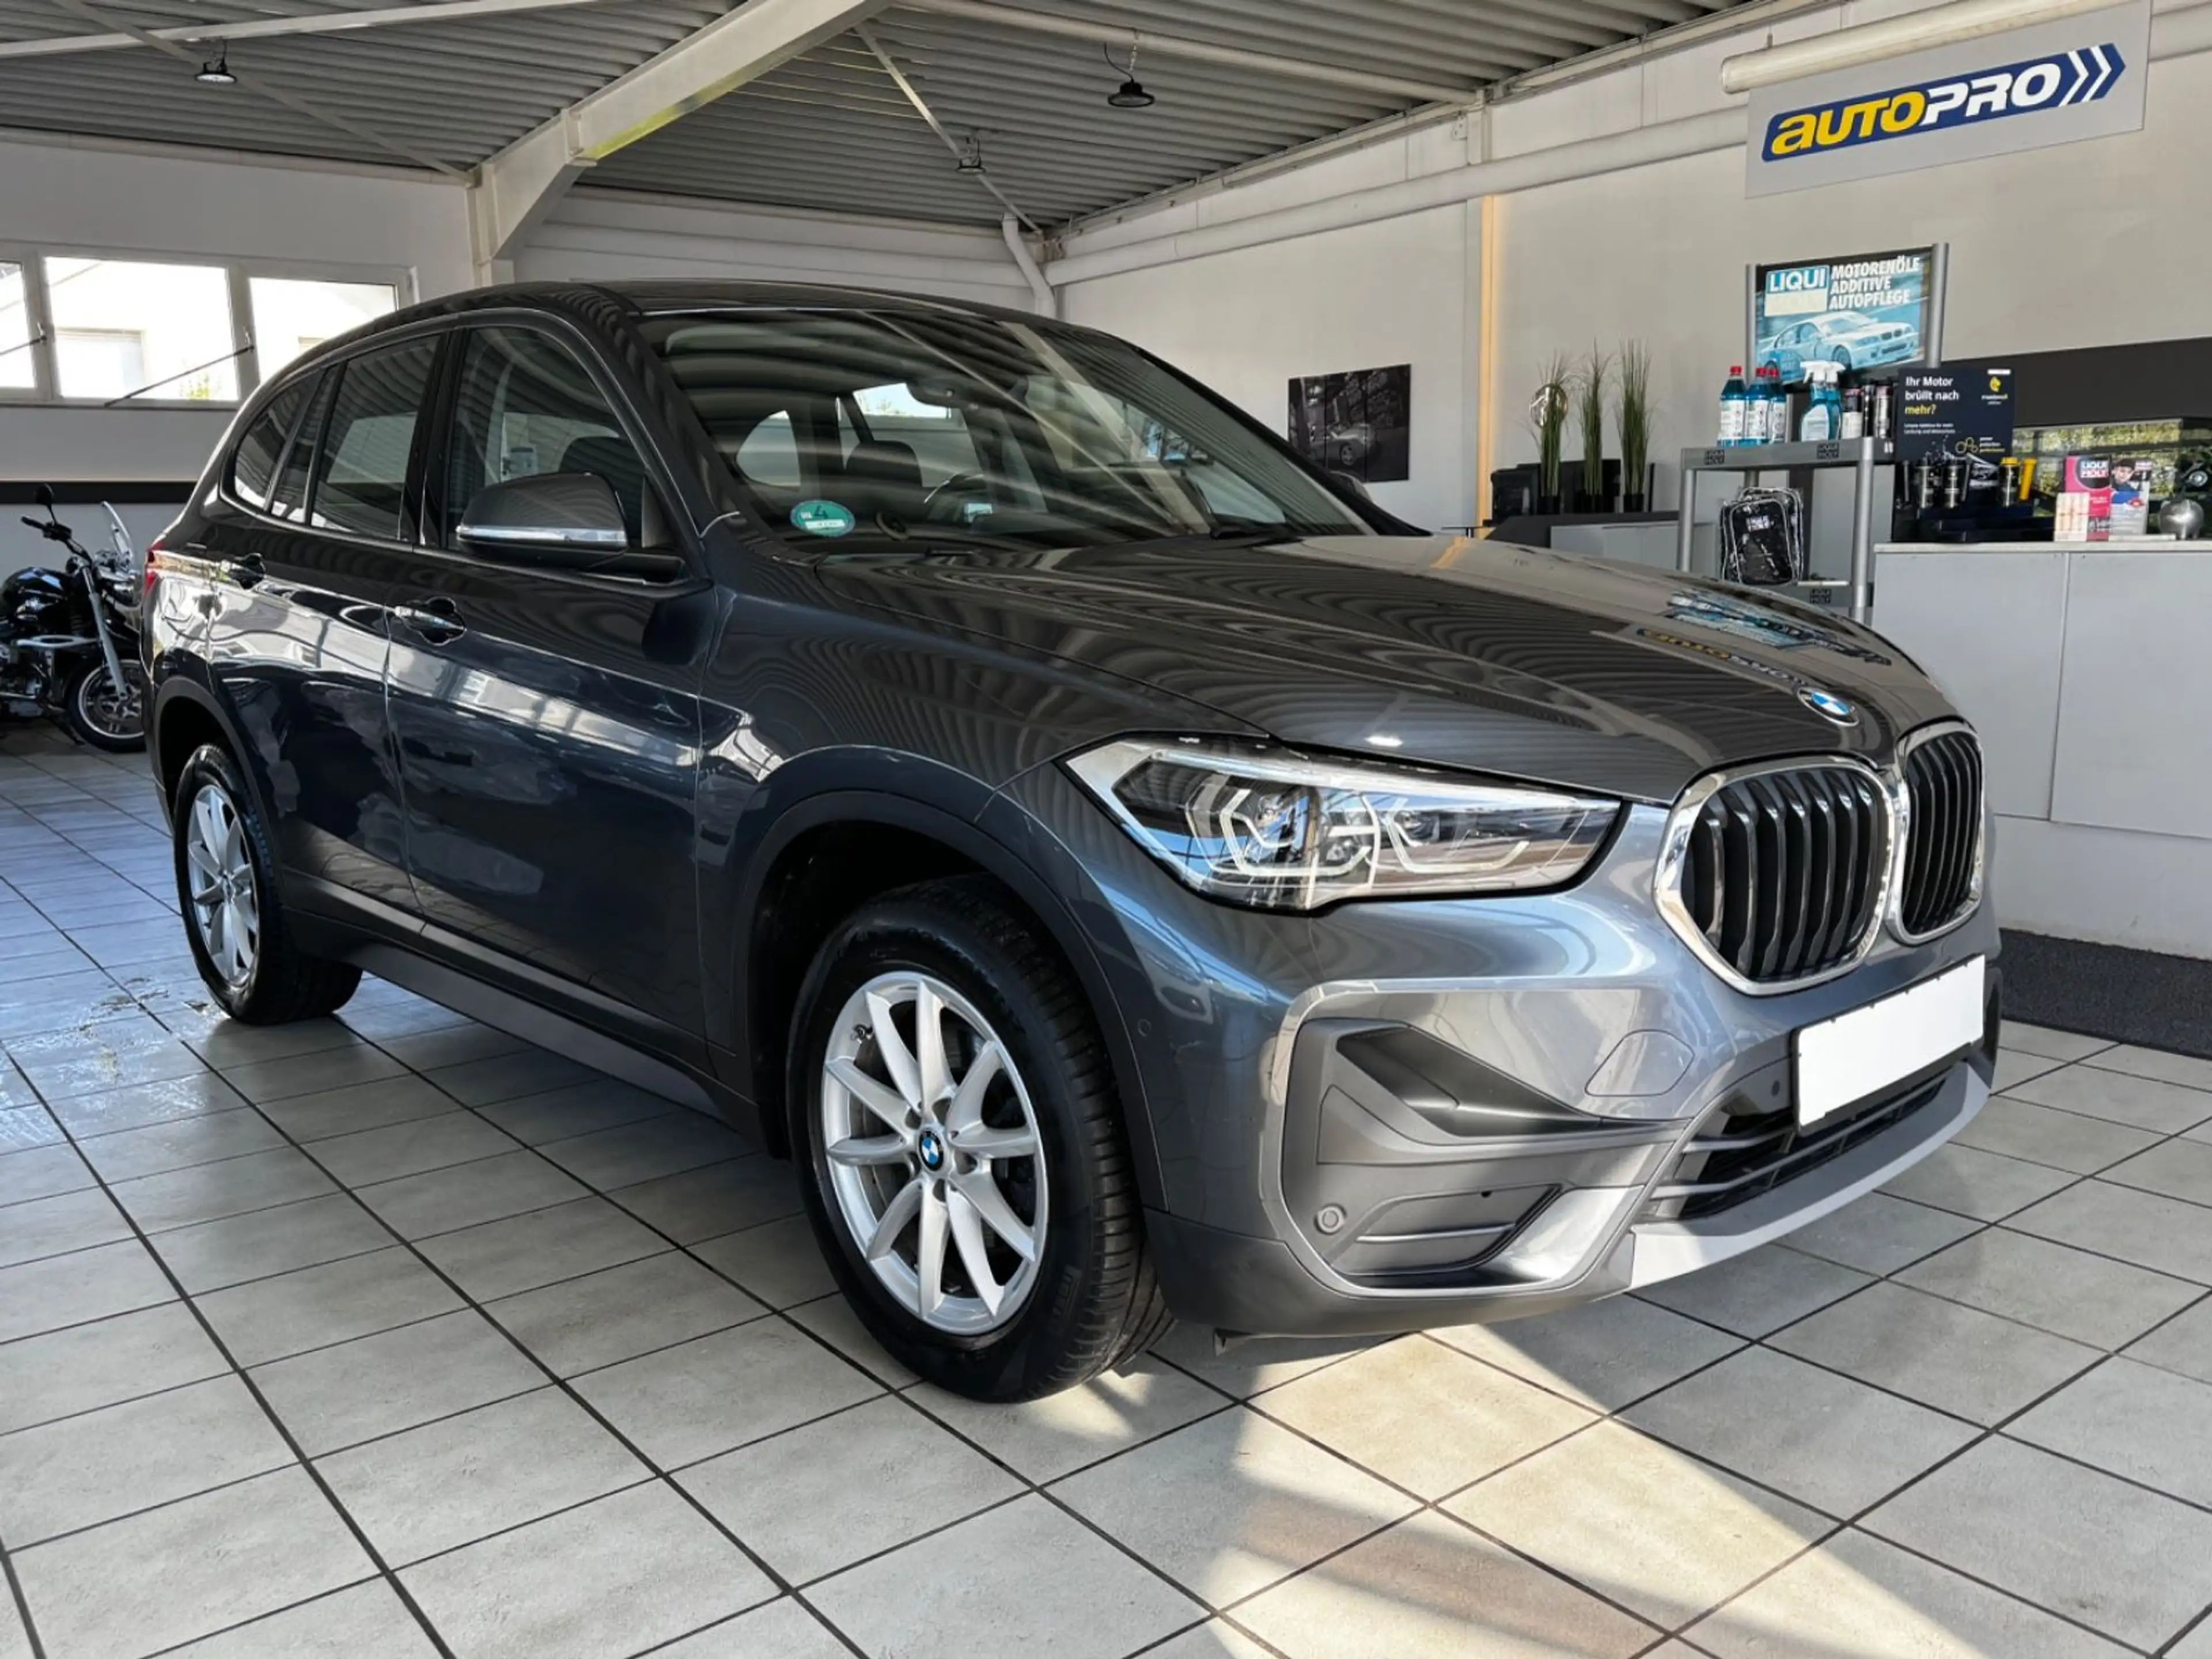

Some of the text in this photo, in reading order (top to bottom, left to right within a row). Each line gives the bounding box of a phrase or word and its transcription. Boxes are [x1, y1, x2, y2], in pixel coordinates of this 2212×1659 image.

[1831, 255, 1921, 279] MOTORENÖLE
[1768, 267, 1826, 292] LIQUI
[1830, 275, 1892, 295] ADDITIVE
[1828, 289, 1911, 310] AUTOPFLEGE
[1906, 376, 1954, 387] Ihr Motor
[1935, 389, 1960, 401] nach
[1904, 404, 1937, 415] mehr?
